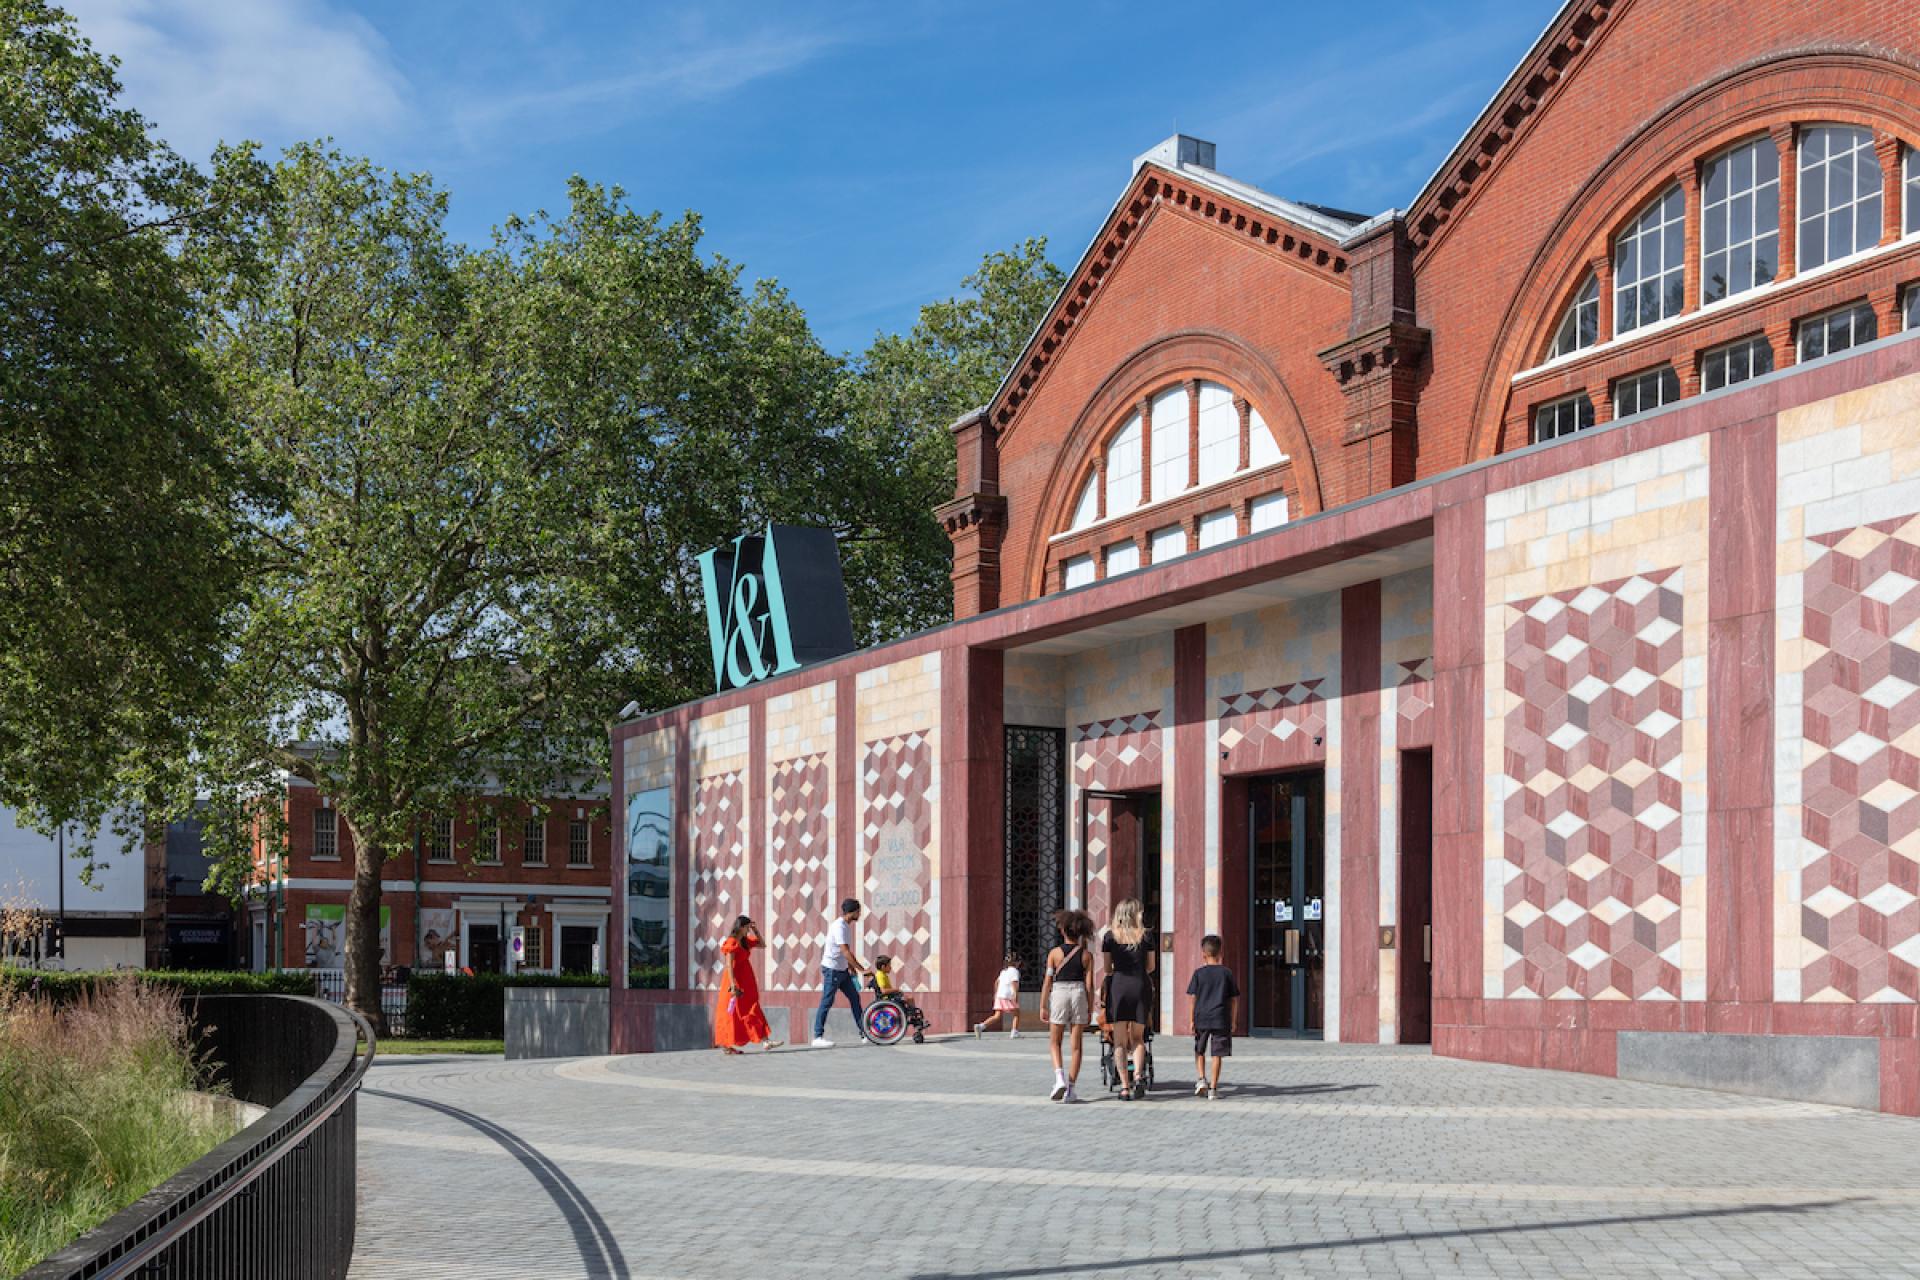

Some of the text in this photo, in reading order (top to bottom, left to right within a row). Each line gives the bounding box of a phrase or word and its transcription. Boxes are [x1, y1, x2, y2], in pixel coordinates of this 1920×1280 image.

[695, 520, 802, 696] V&A
[873, 890, 920, 907] CHILDHOOD
[179, 929, 221, 937] ACCESSIBLE
[182, 936, 218, 944] ENTRANCE
